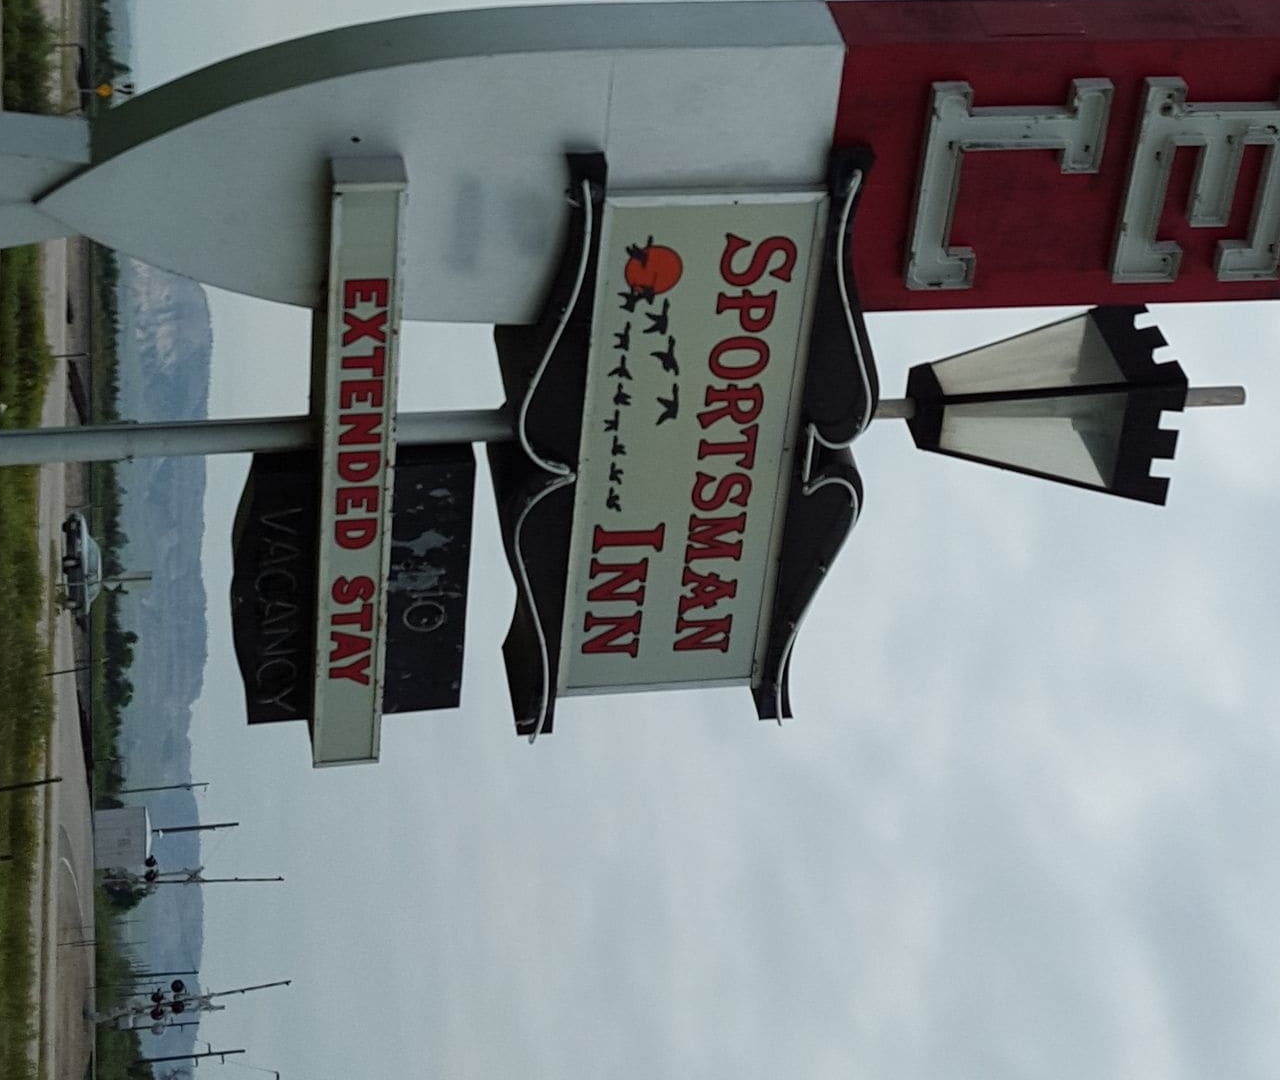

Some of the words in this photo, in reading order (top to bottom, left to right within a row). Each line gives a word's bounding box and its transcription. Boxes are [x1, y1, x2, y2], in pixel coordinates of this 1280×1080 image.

[335, 278, 389, 550] EXTENDED
[673, 232, 798, 653] SPORTSMAN
[253, 506, 304, 712] VACANCY
[328, 576, 375, 686] STAY
[581, 523, 666, 658] INN
